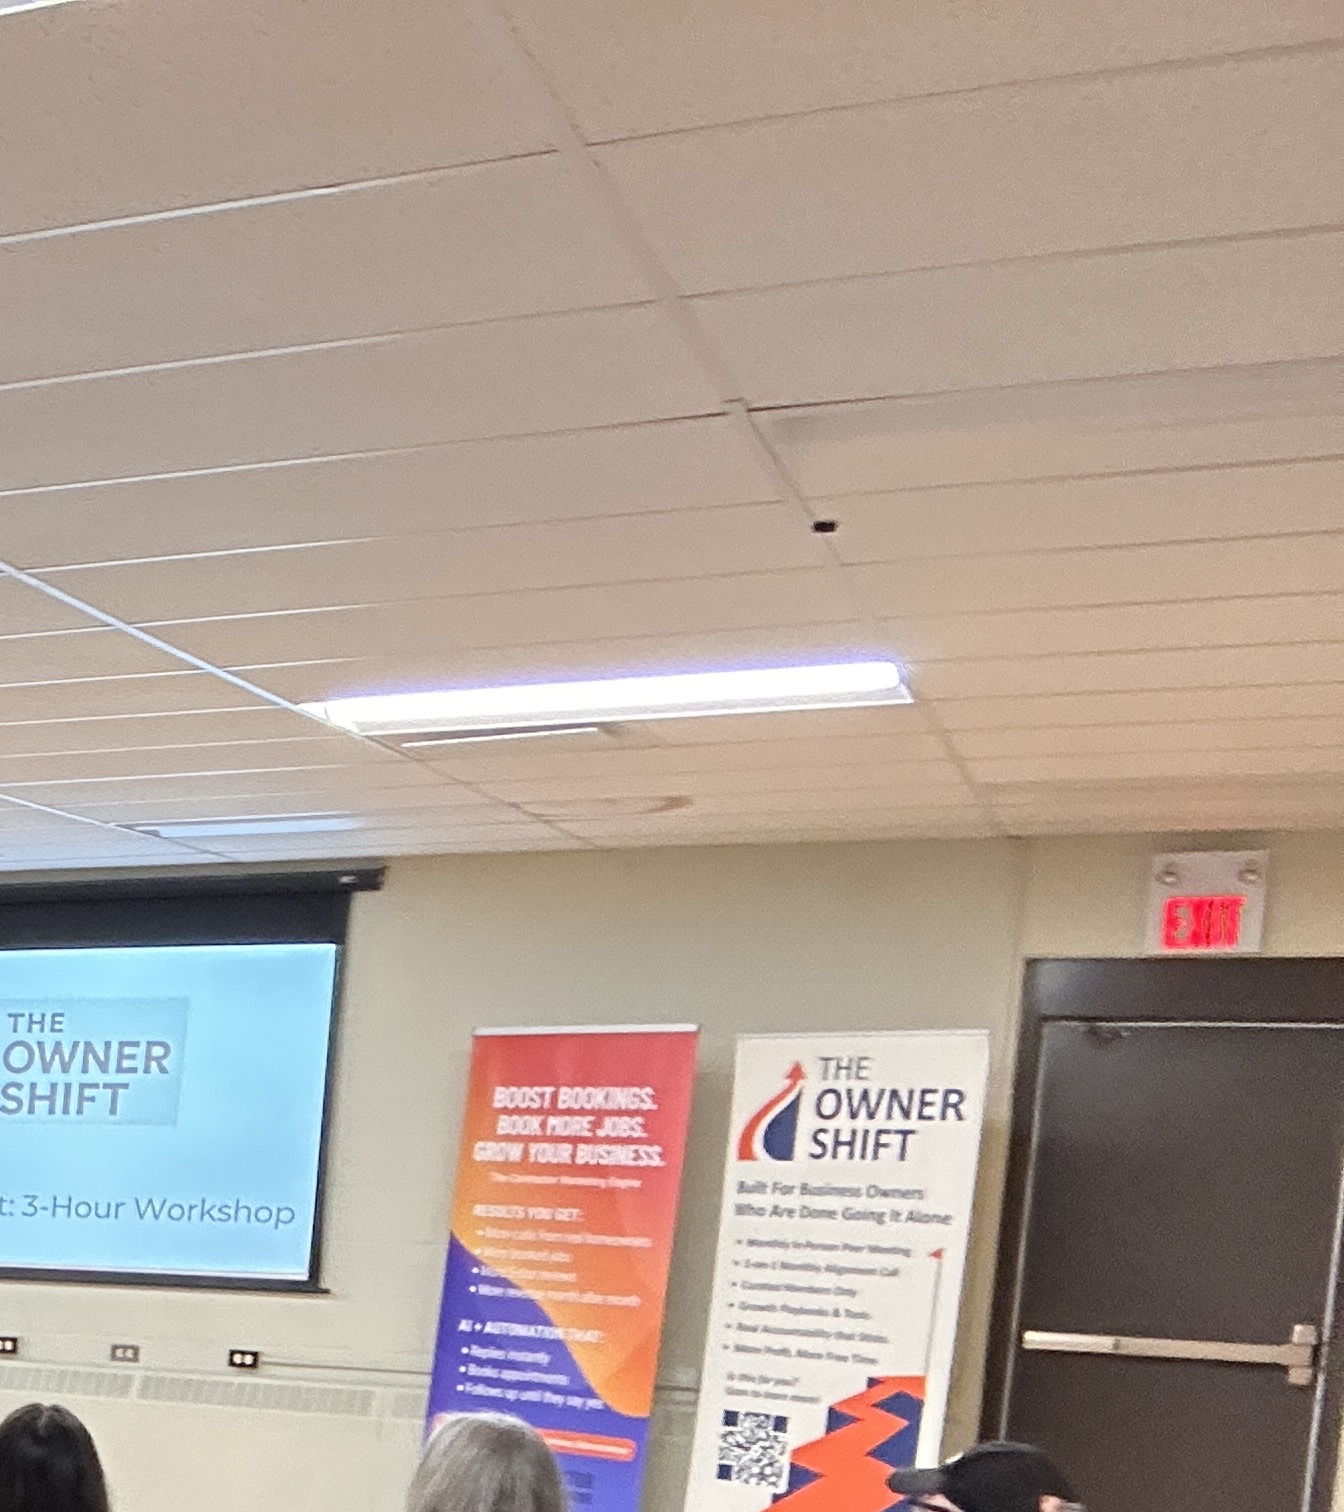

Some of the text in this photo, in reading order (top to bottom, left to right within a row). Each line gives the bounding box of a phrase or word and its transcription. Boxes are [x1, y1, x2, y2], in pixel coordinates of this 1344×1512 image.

[1163, 895, 1247, 949] EXIT
[7, 1012, 65, 1033] THE
[2, 1040, 171, 1074] OWNER
[820, 1056, 872, 1081] THE
[493, 1086, 556, 1109] BOOST
[815, 1088, 966, 1122] OWNER
[496, 1115, 544, 1136] BOOK
[547, 1116, 594, 1137] MORE
[473, 1142, 524, 1162] GROW
[529, 1143, 572, 1164] YOUR
[808, 1129, 915, 1161] SHIFT
[736, 1180, 924, 1200] Built For Business Owners
[21, 1194, 126, 1220] 3-Hour
[134, 1197, 296, 1229] Workshop
[735, 1204, 953, 1226] Who Are Done Going It Alone
